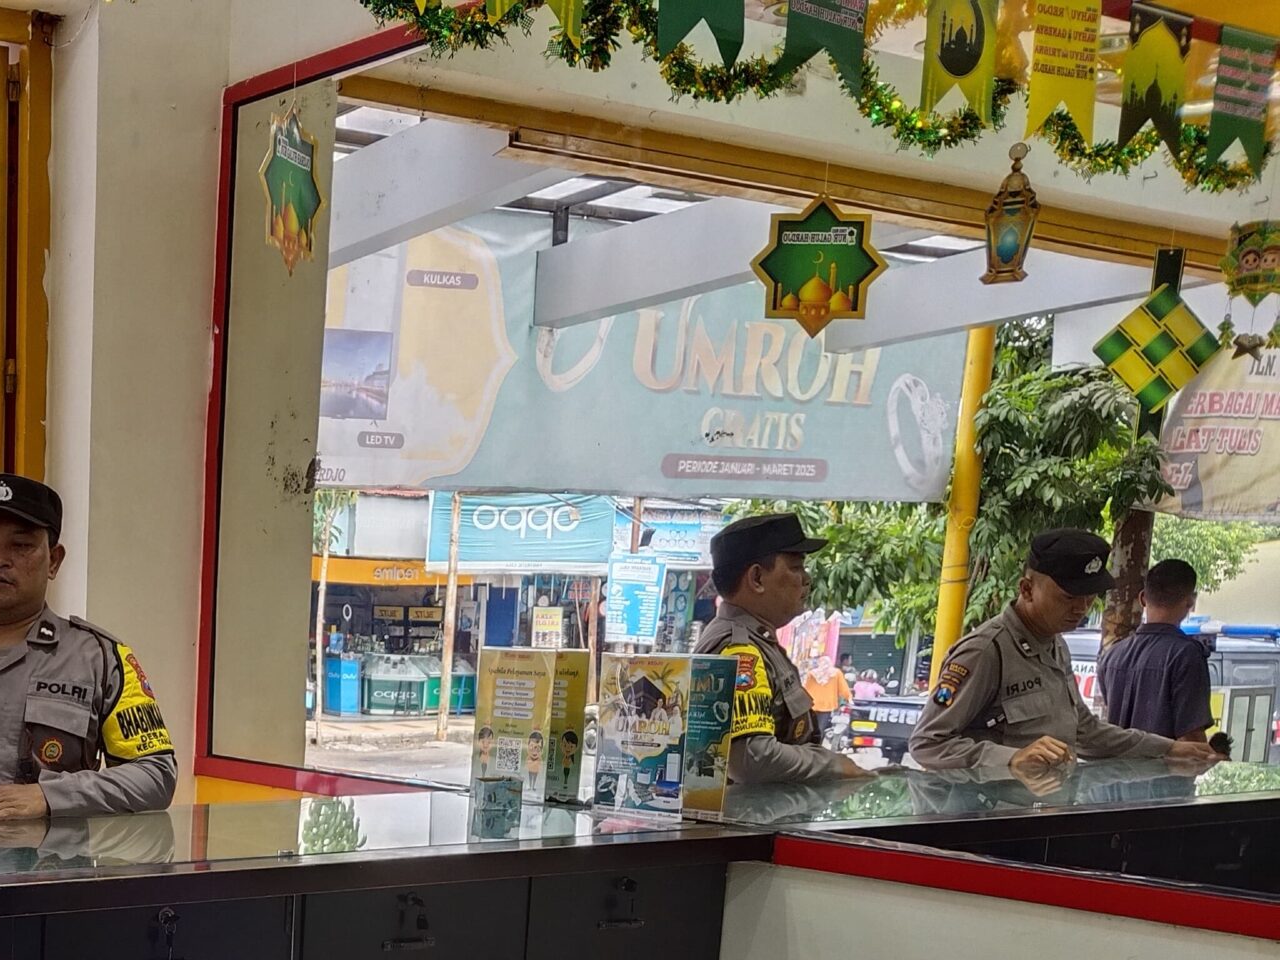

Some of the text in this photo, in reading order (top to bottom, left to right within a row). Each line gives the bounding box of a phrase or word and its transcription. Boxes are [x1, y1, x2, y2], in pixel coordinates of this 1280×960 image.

[423, 273, 462, 286] KULKAS
[632, 296, 882, 406] UMROH
[700, 407, 807, 451] GRATIS
[366, 434, 396, 446] LED TV
[1217, 427, 1263, 453] TULIS
[678, 460, 719, 475] PERIODE
[720, 460, 755, 475] JANUARI
[762, 462, 794, 477] MARET
[795, 463, 816, 477] 2025
[35, 681, 88, 701] POLRI
